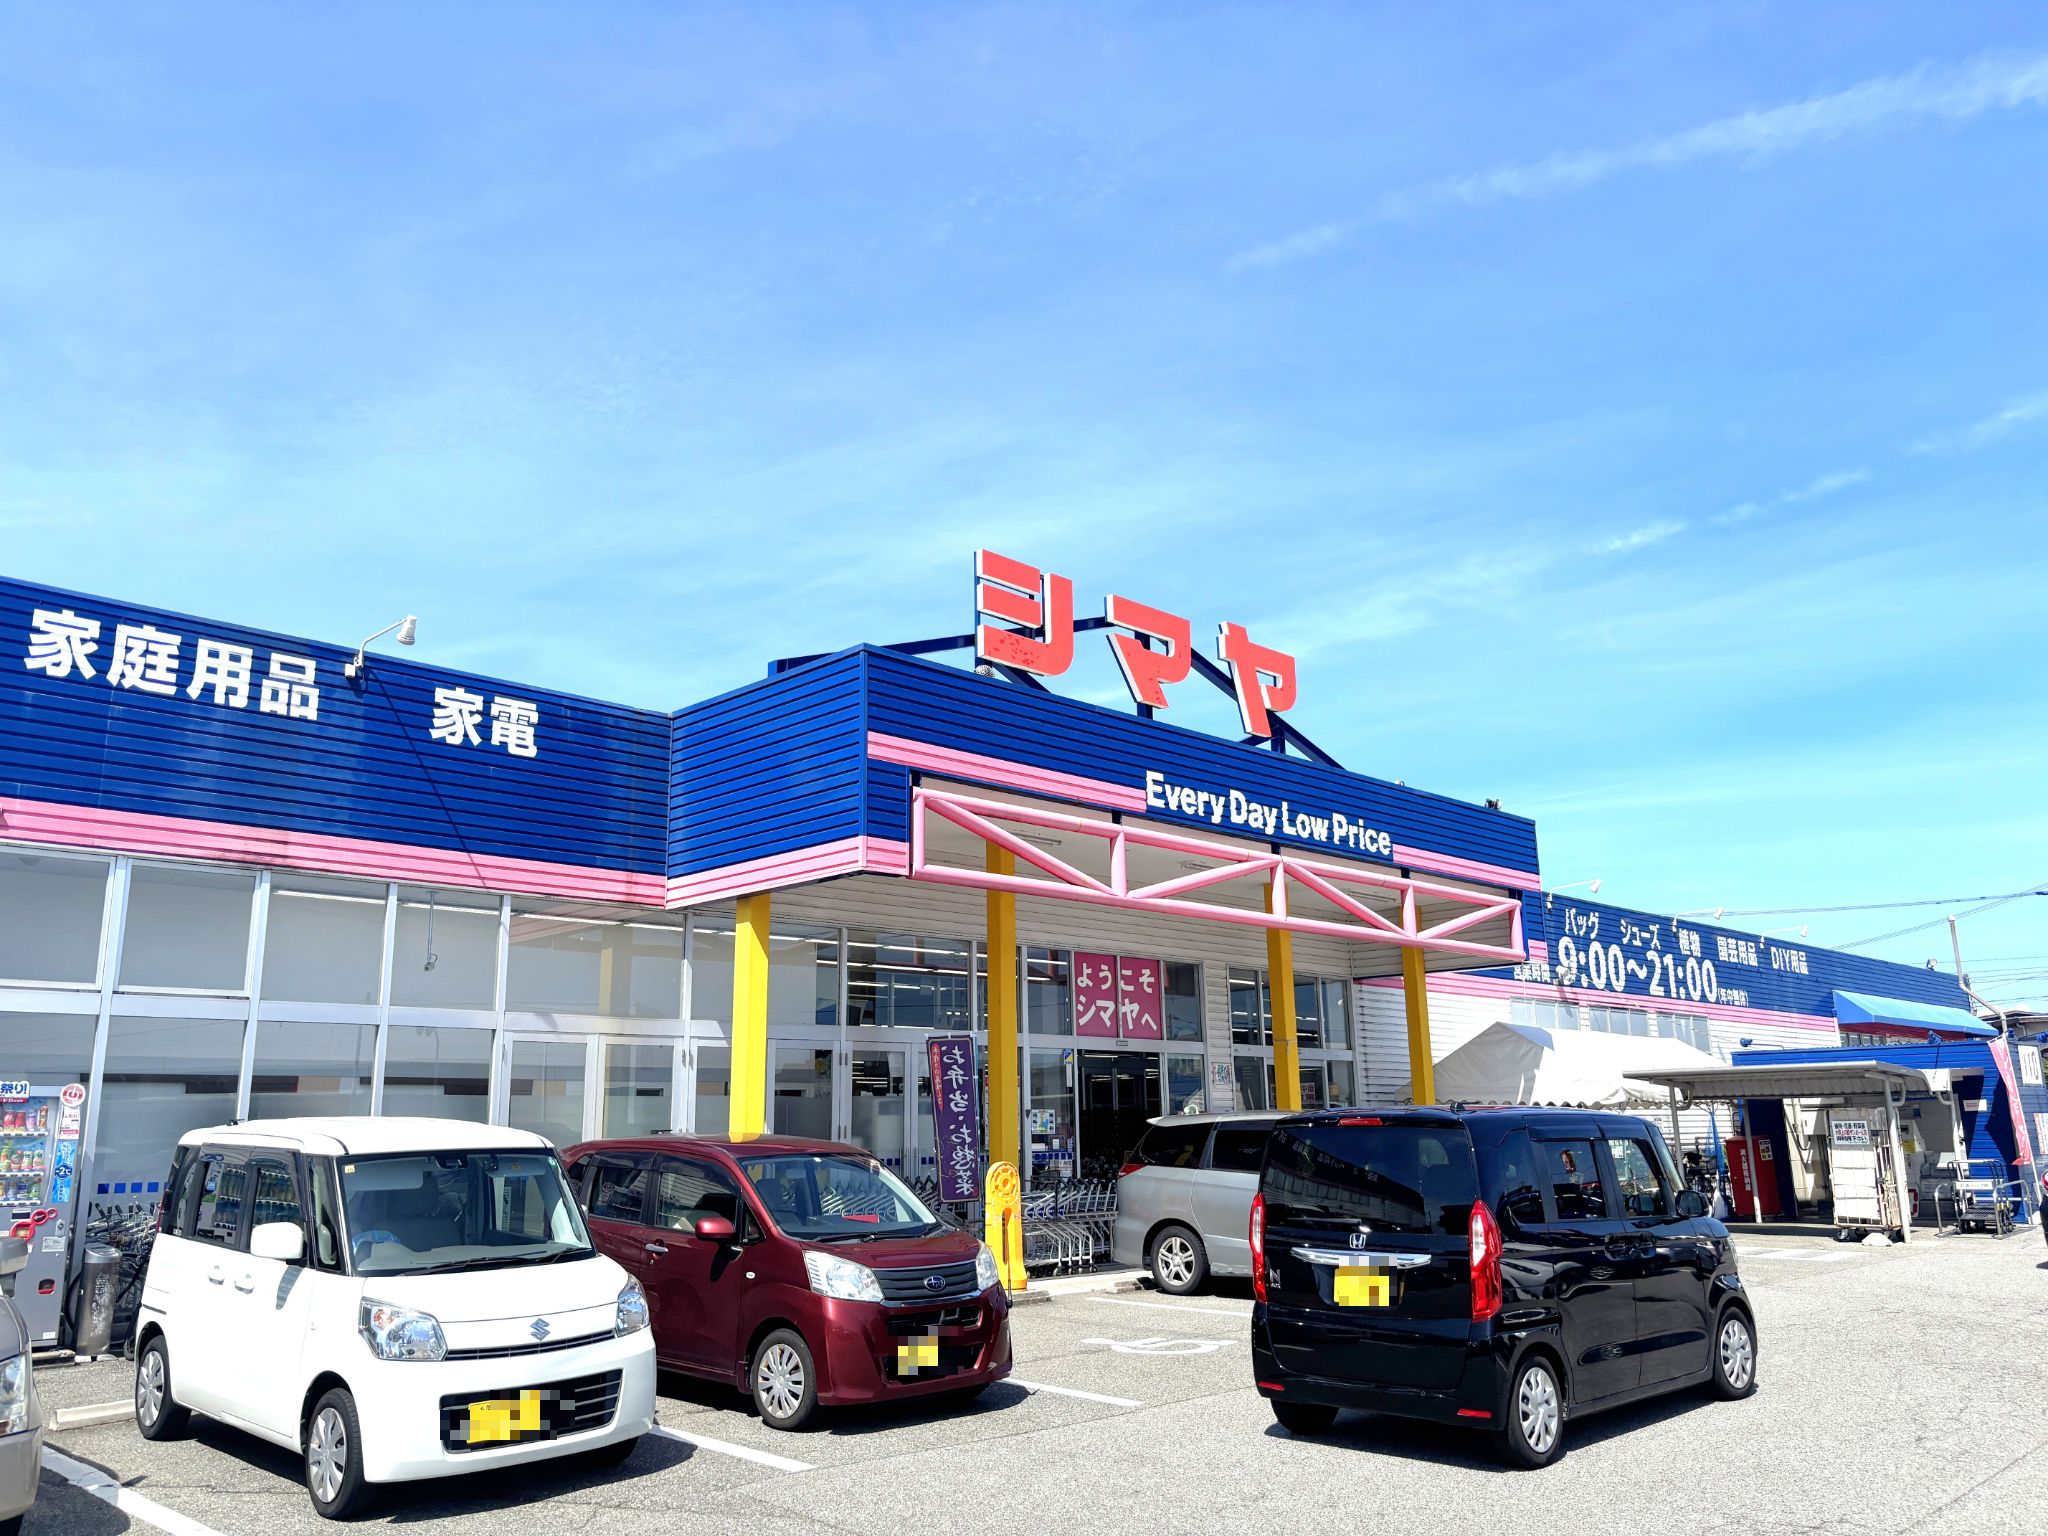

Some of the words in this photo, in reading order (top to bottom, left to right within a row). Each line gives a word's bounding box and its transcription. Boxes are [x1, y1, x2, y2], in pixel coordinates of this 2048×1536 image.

[976, 549, 1297, 737] シマヤ
[23, 608, 320, 721] 家庭用品
[428, 687, 540, 758] 家電
[1145, 770, 1225, 824] Every
[1230, 790, 1279, 835] Day
[1282, 801, 1328, 841] Low
[1333, 813, 1392, 856] Price
[1076, 962, 1156, 993] ようこそ
[1565, 908, 1599, 940] バッグ
[1620, 919, 1662, 950] シューズ
[1678, 927, 1702, 957] 植物
[1717, 936, 1759, 967] 園芸用品
[1770, 946, 1809, 975] DIY用品
[1076, 994, 1159, 1032] シマヤへ
